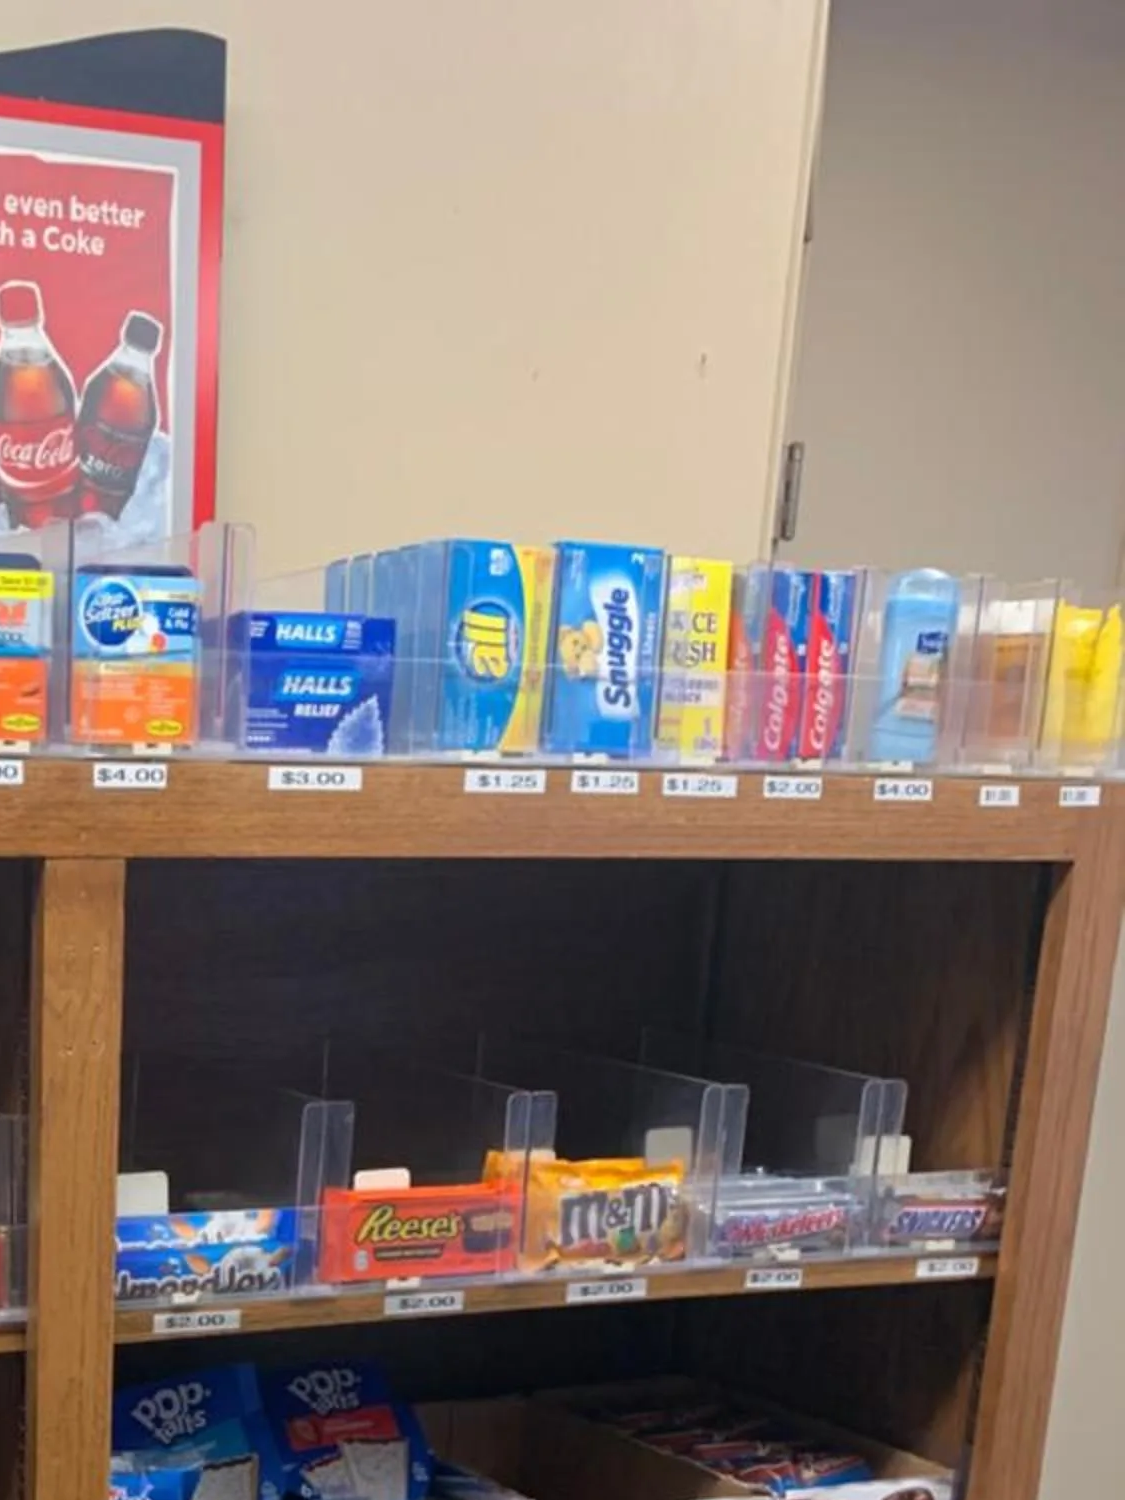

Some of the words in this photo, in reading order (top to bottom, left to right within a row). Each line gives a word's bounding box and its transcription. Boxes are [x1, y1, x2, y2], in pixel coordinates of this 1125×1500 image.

[4, 191, 63, 220] even
[70, 195, 145, 229] better
[21, 230, 37, 249] a
[42, 229, 105, 256] Coke
[276, 623, 337, 643] HALLS
[603, 587, 633, 709] Snuggle
[282, 675, 352, 695] HALLS
[763, 635, 792, 752] Colgate
[809, 638, 836, 751] Colgate
[293, 703, 340, 718] RELIEF
[96, 767, 165, 783] $4.00
[280, 770, 346, 785] $3.00
[478, 774, 537, 788] $1.25
[577, 776, 636, 789] $1.25
[666, 778, 722, 792] $1.25
[766, 780, 820, 794] $2.00
[877, 784, 929, 798] $4.00
[355, 1204, 463, 1244] Reese's
[116, 1268, 220, 1299] lmond
[579, 1282, 634, 1296] $2.00
[398, 1295, 456, 1309] $2.00
[165, 1314, 226, 1329] $2.00
